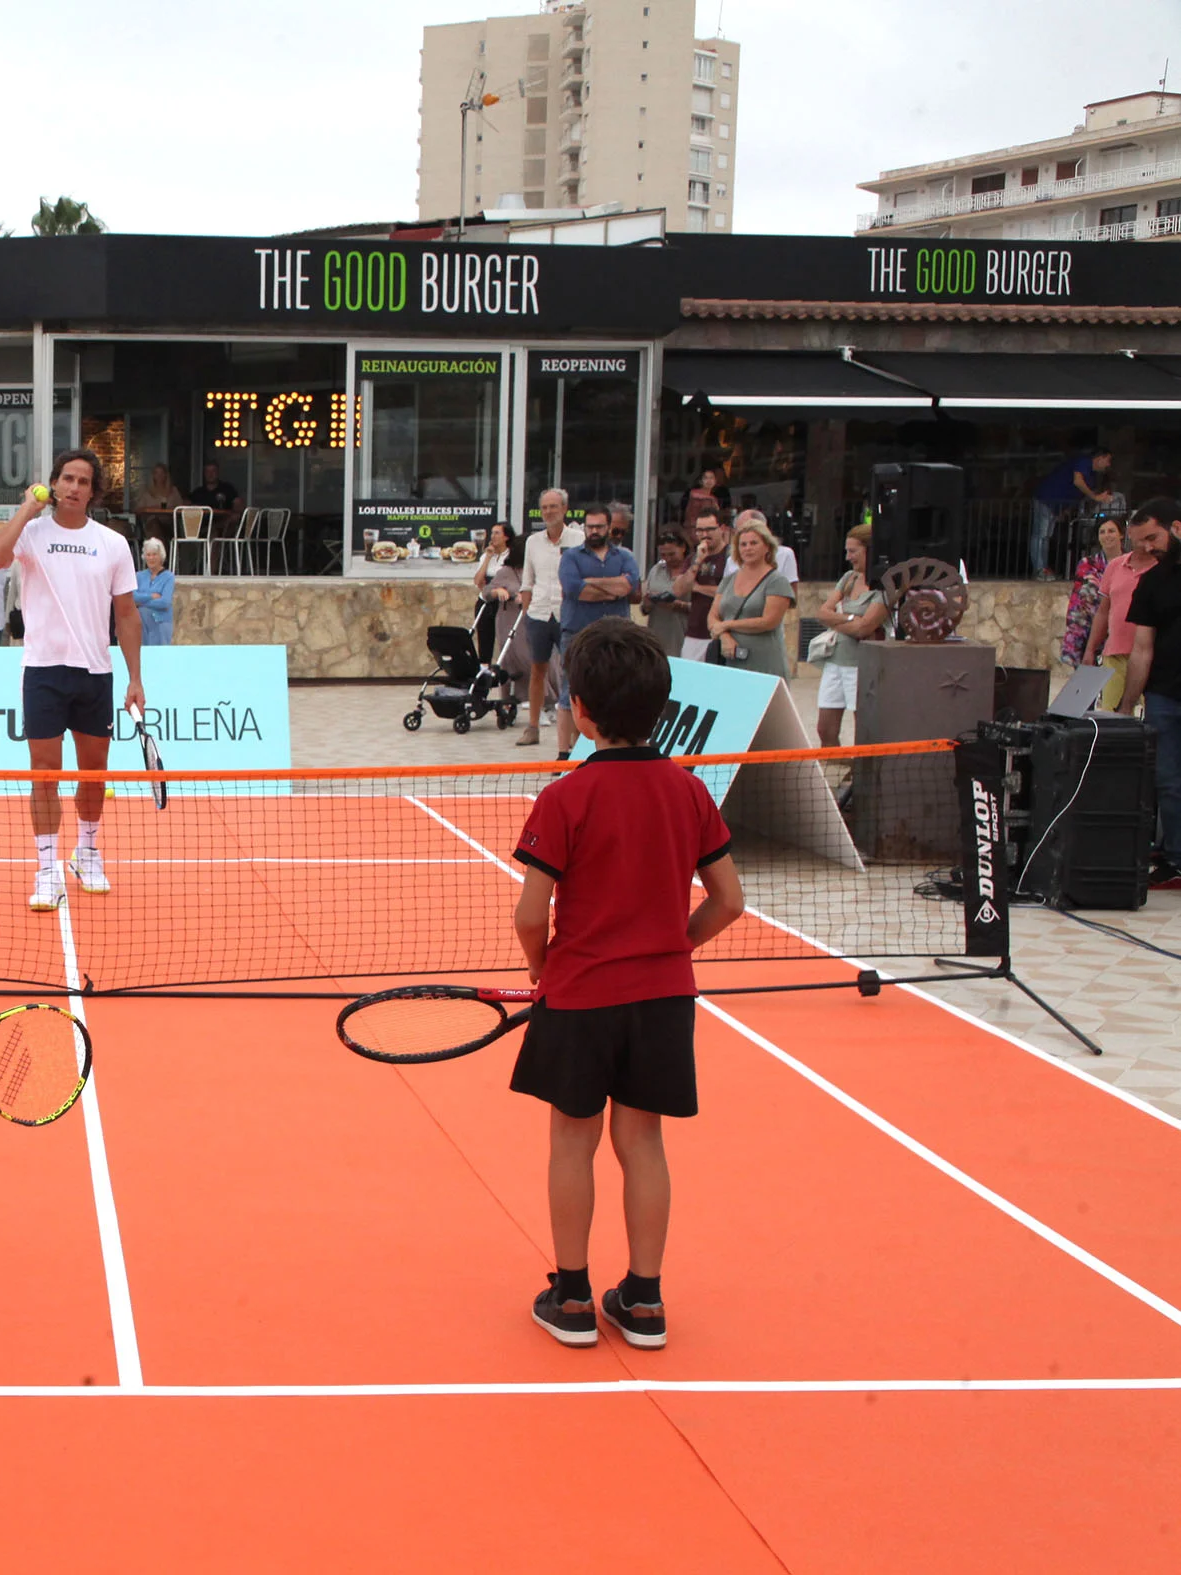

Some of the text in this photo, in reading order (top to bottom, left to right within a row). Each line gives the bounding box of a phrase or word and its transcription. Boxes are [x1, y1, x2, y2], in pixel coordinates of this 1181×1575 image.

[254, 249, 539, 315] THE GOOD BURGER
[867, 248, 1072, 296] THE GOOD BURGER
[361, 358, 497, 374] REINAUGURACIÓN
[541, 358, 626, 372] REOPENING
[358, 506, 492, 516] LOS FINALES FELICES EXISTEN
[109, 701, 263, 742] DRILEÑA
[990, 793, 1000, 842] SPORT
[972, 779, 994, 900] DUNLOP
[498, 988, 531, 997] TRIAD
